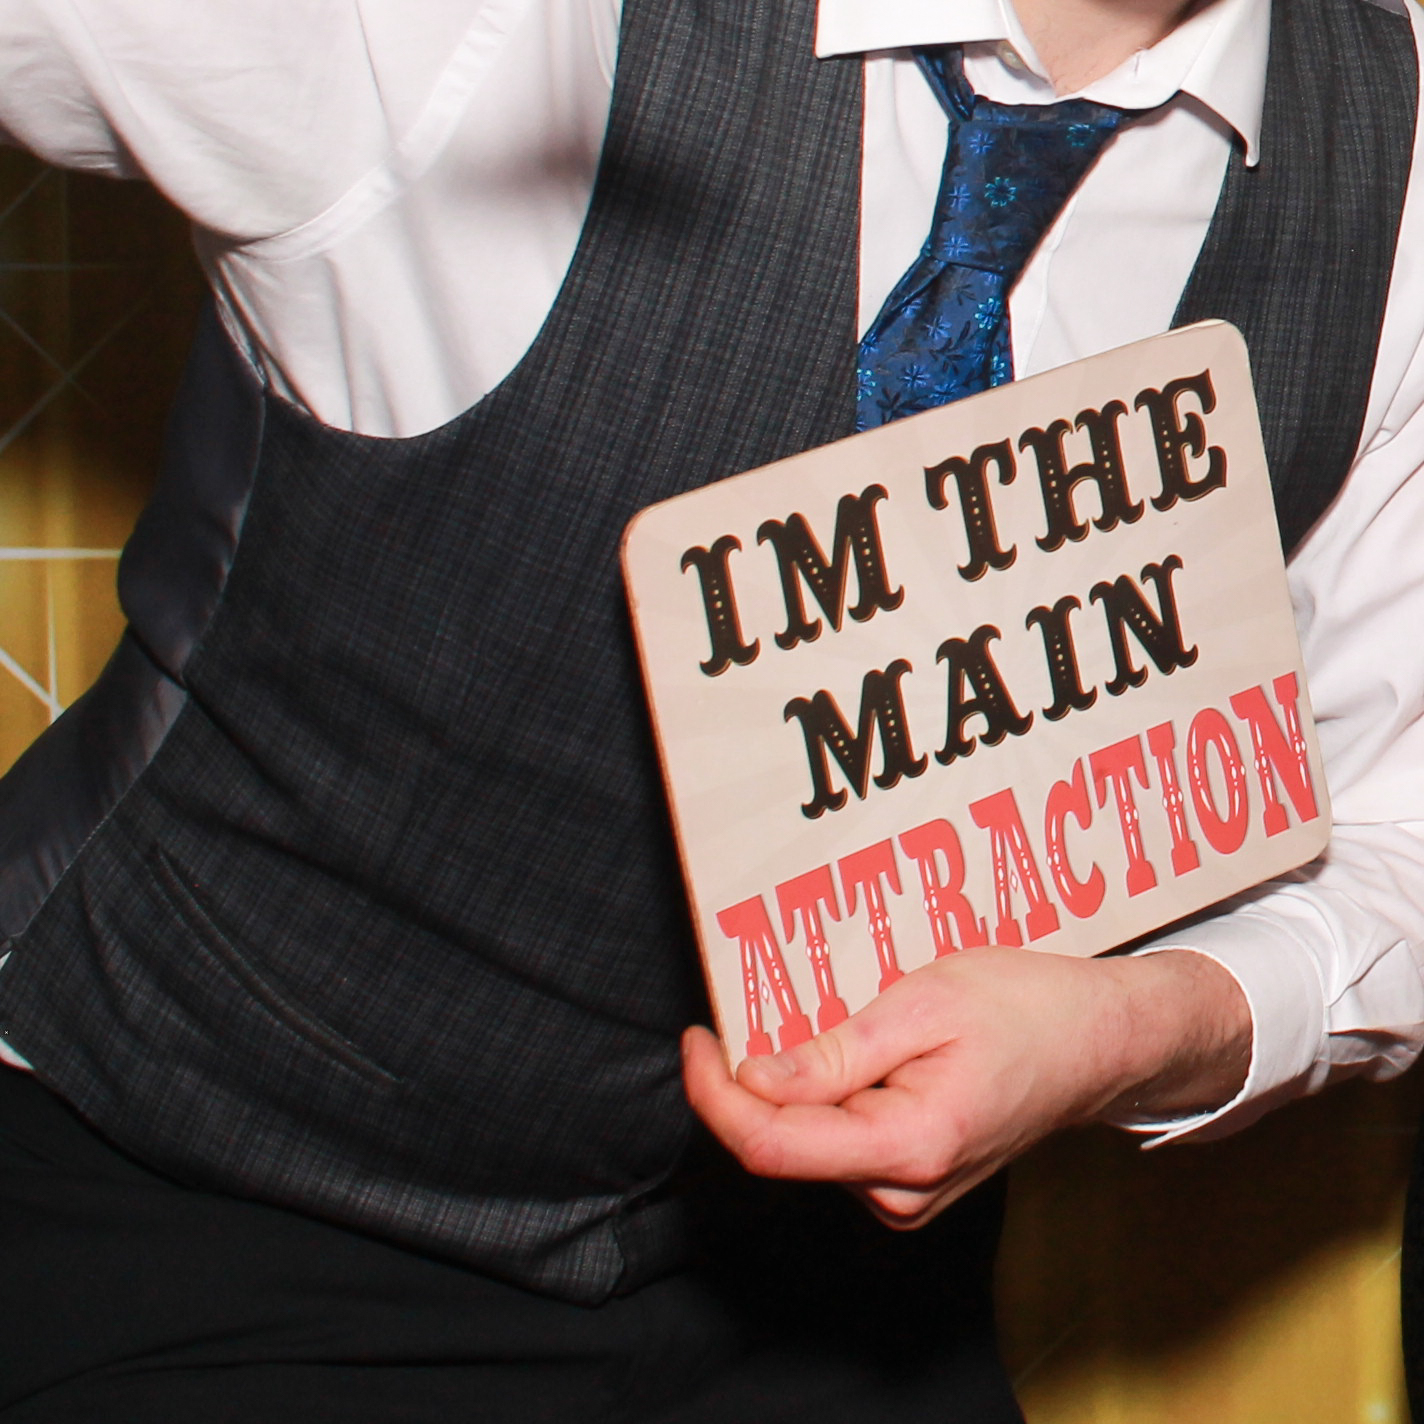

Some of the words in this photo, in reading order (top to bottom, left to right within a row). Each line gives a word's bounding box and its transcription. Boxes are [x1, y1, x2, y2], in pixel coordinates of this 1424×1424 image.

[680, 483, 905, 677] IM
[924, 368, 1228, 582] THE
[784, 554, 1200, 820] MAIN
[716, 671, 1319, 1056] ATTRACTION
